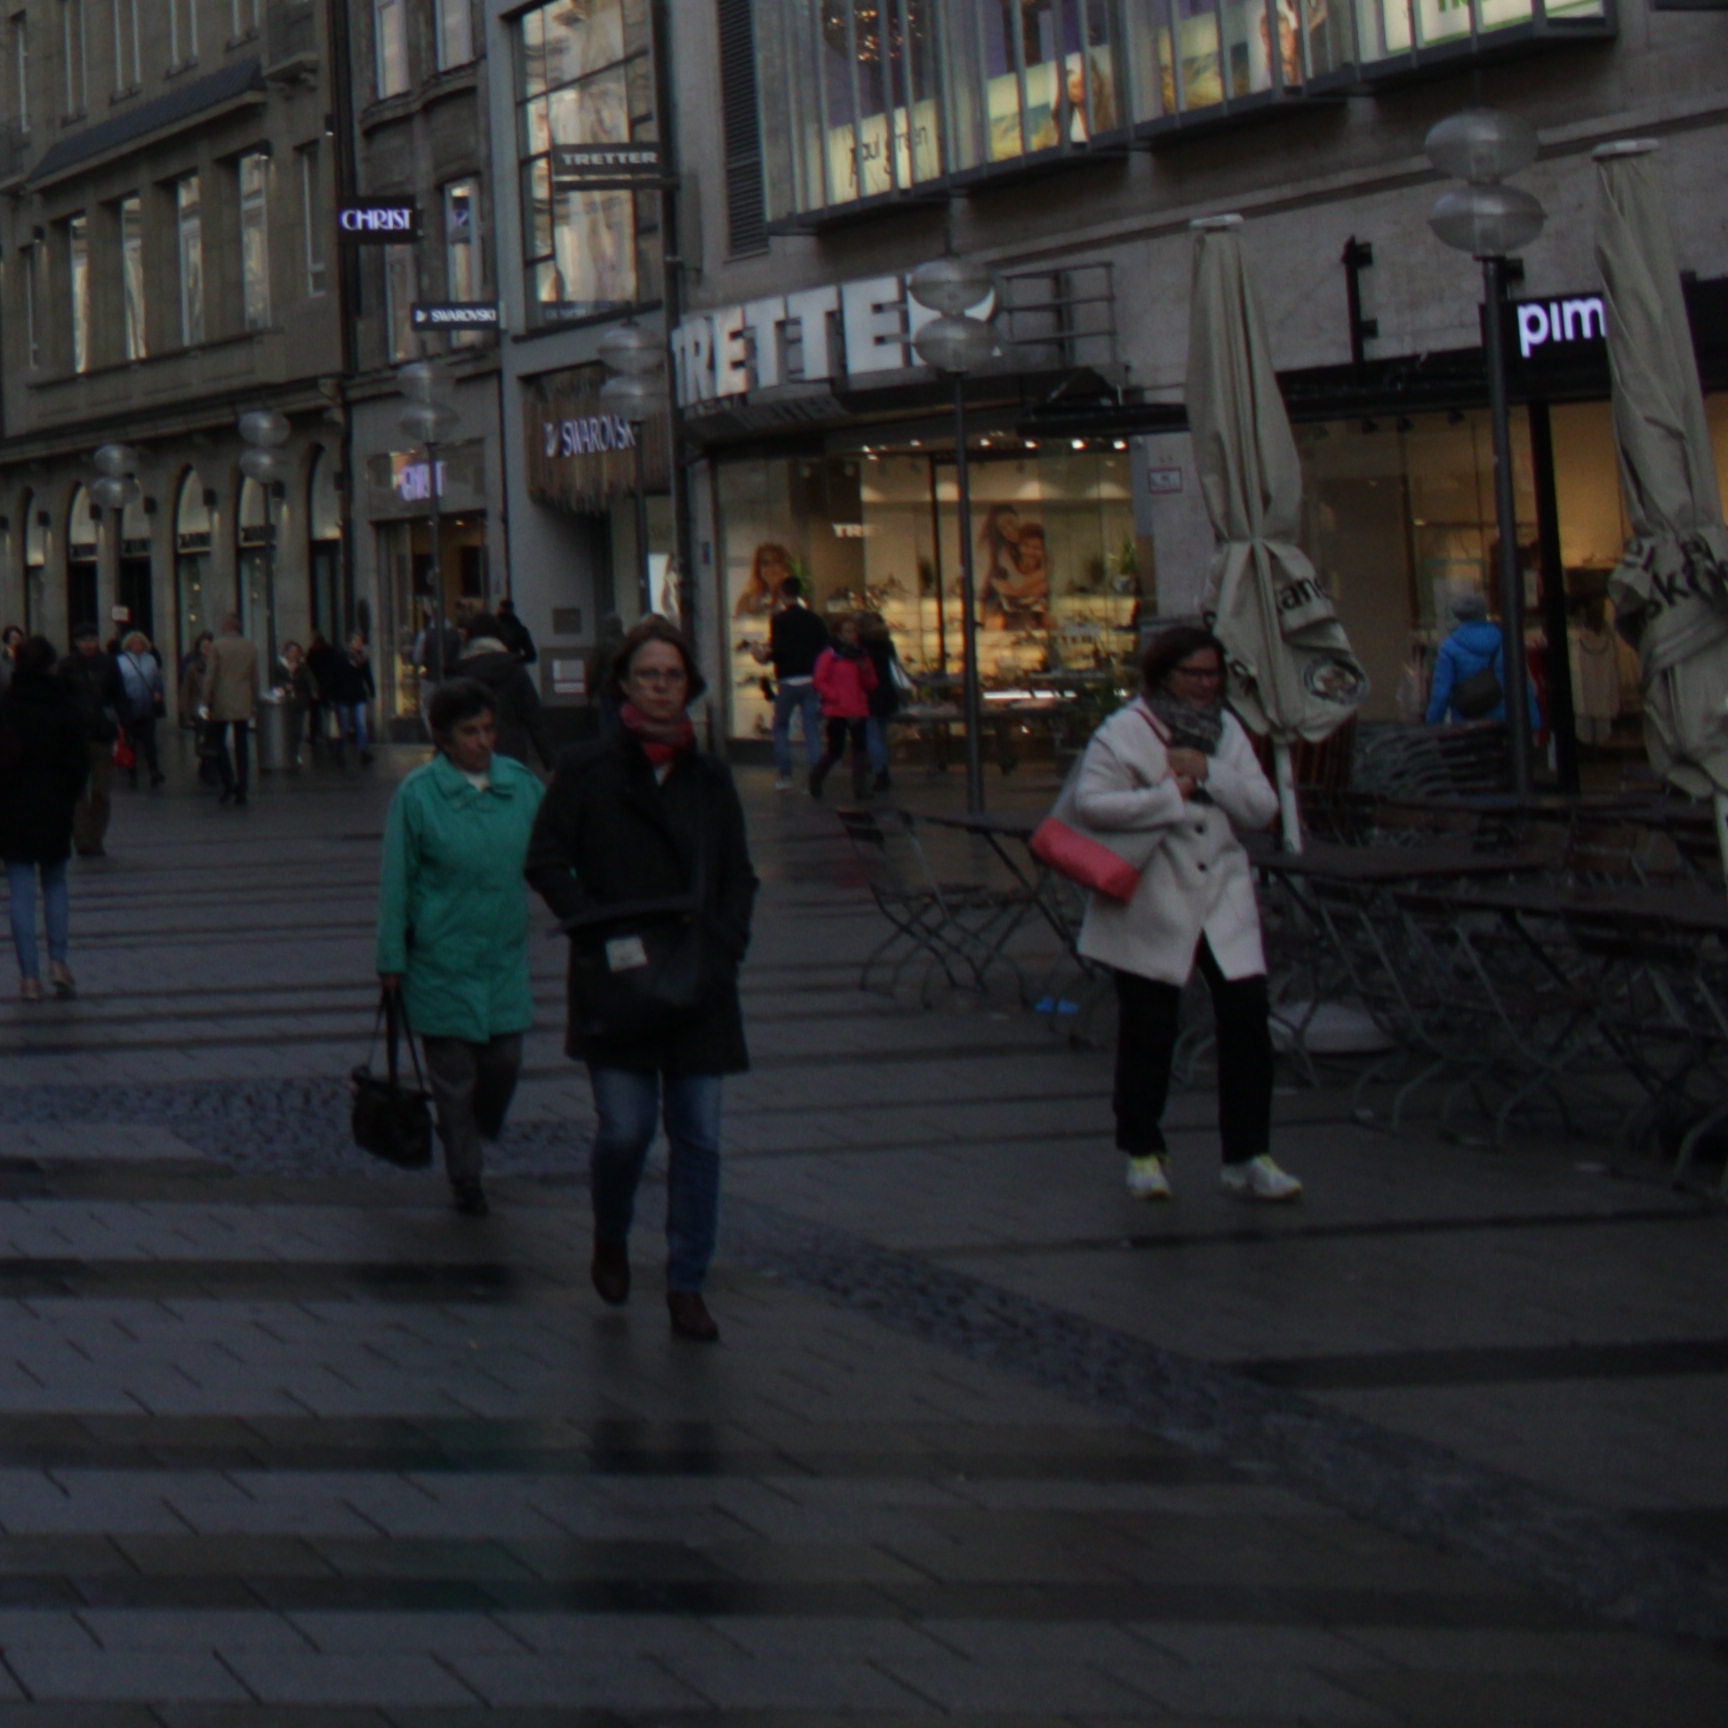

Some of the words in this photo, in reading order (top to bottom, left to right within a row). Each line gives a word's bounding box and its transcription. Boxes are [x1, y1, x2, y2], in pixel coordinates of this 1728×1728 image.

[561, 151, 659, 165] TRETTER
[340, 207, 414, 231] CHRIST
[431, 308, 497, 322] SWAROVSKI
[671, 273, 1002, 410] TRETTE
[562, 414, 639, 458] SWAROVSK
